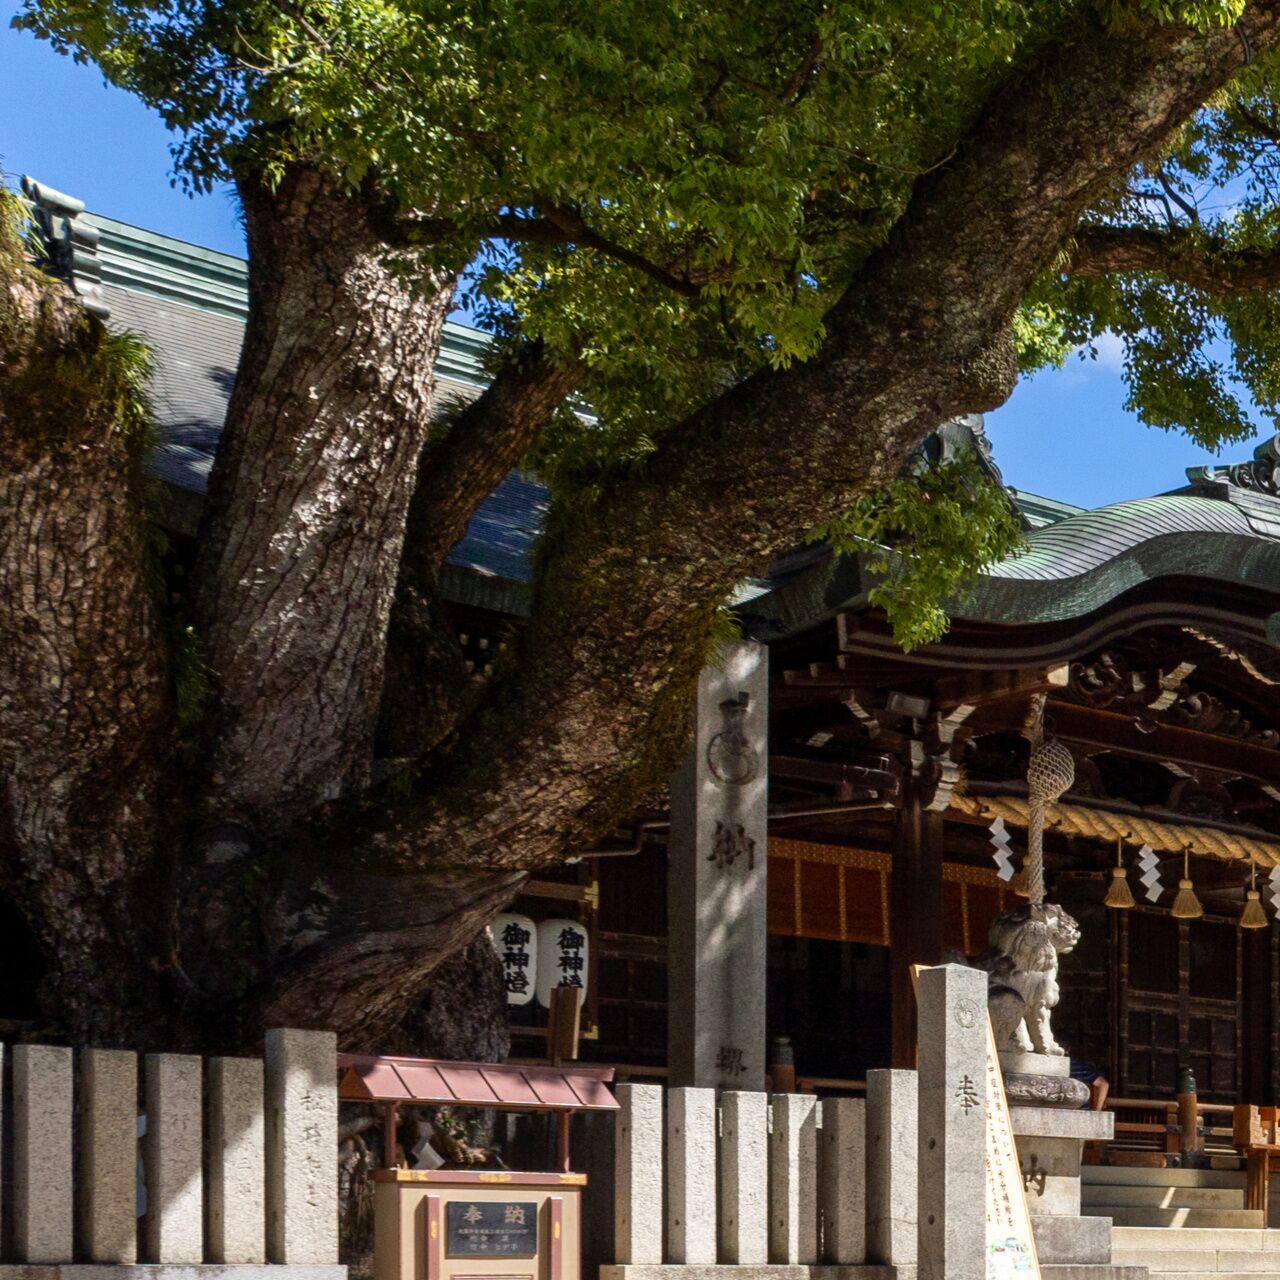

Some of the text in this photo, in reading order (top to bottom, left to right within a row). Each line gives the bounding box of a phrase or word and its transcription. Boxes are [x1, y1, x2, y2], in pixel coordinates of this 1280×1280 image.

[501, 922, 531, 995] 御神燈
[955, 1075, 981, 1117] 奉
[463, 1204, 525, 1225] 奉納
